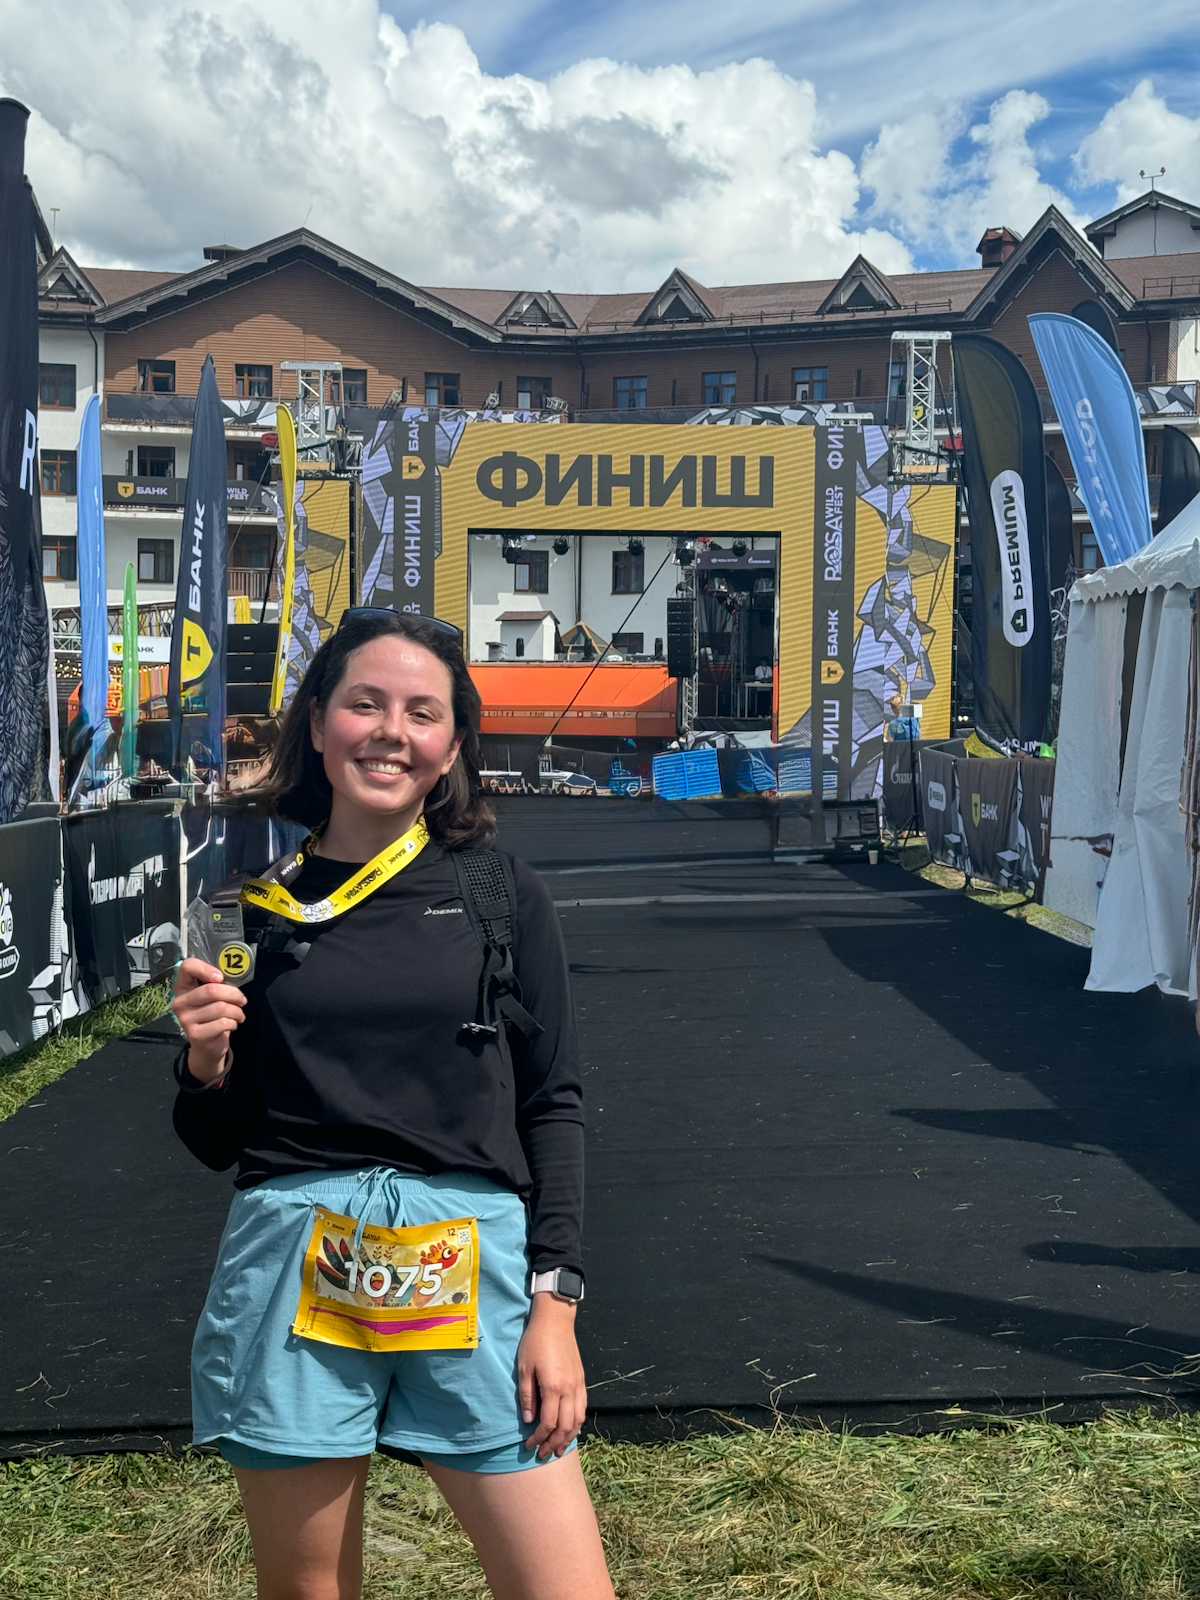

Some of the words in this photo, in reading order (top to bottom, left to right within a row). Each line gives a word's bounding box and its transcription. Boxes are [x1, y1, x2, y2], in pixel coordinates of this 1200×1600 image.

[926, 407, 953, 416] АНК
[136, 486, 169, 496] БАНК
[476, 451, 774, 508] ФИНИШ
[825, 488, 834, 519] WILD
[834, 485, 844, 514] FEST
[188, 499, 206, 613] БАНК
[404, 495, 422, 588] ФИНИШ
[826, 608, 839, 657] БАНК
[981, 803, 998, 821] БАНК
[224, 953, 244, 968] 12
[447, 1227, 456, 1236] 12
[344, 1261, 443, 1298] 1075
